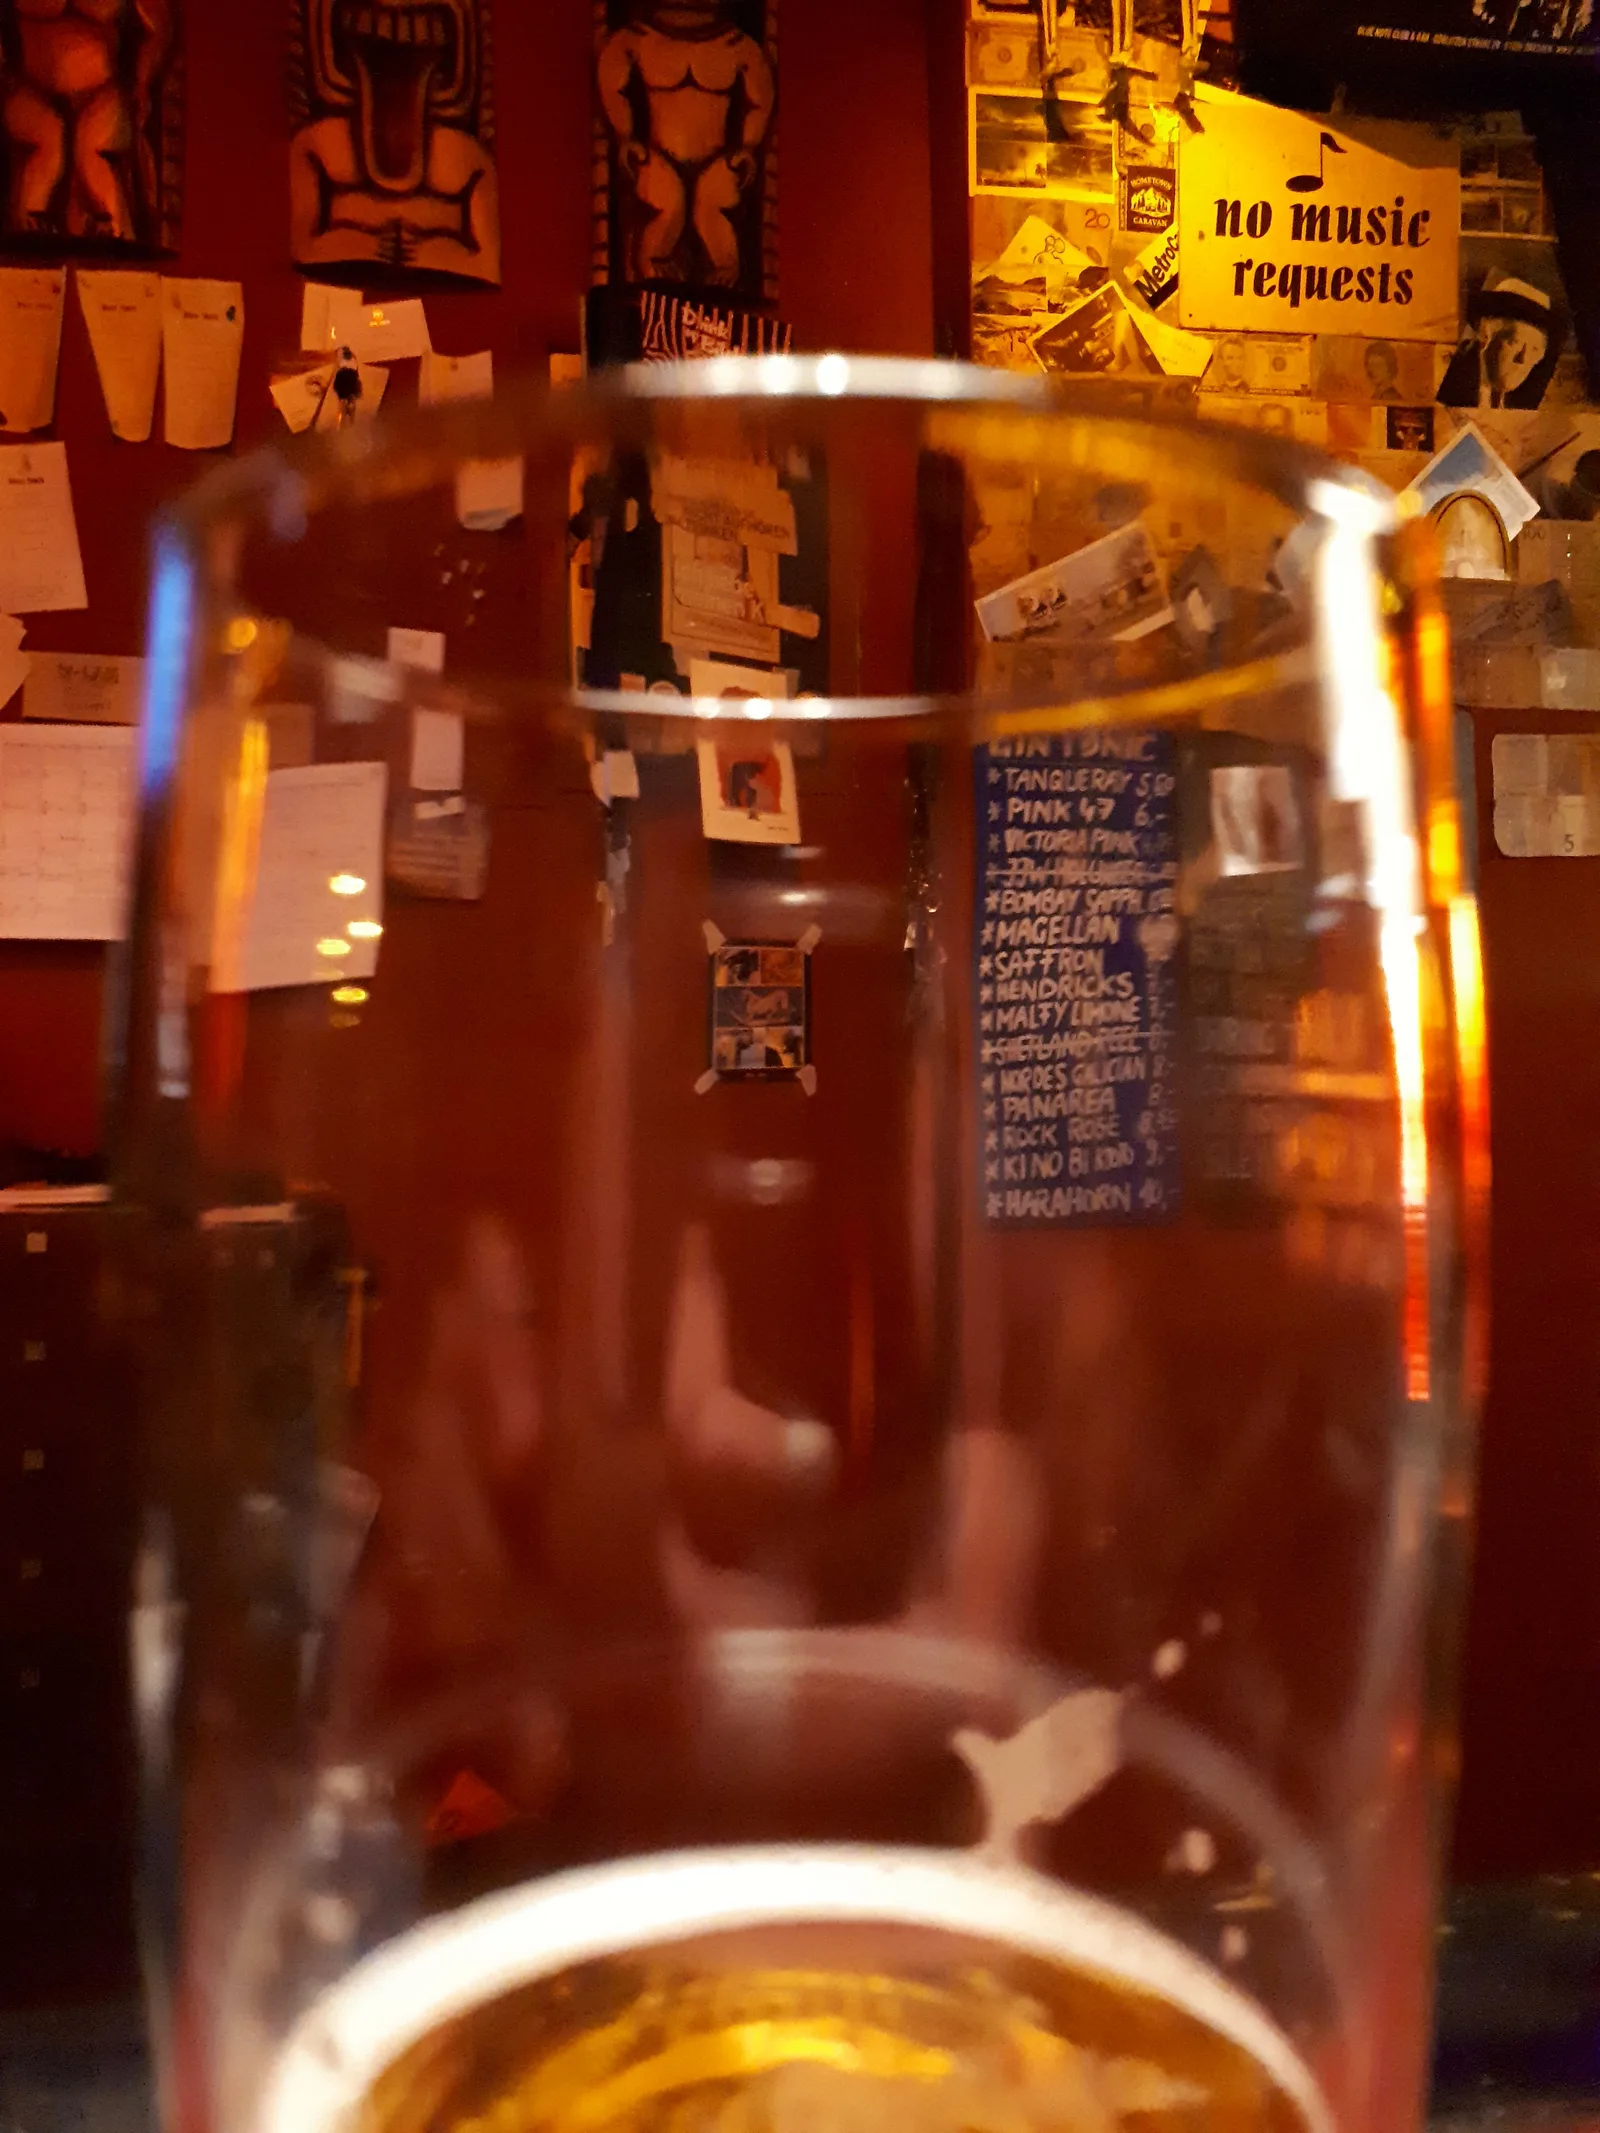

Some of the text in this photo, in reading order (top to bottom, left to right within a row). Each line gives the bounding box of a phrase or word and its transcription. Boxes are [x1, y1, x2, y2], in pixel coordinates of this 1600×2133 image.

[1130, 175, 1173, 191] HOMETOWN
[1085, 208, 1111, 228] 20
[1132, 216, 1168, 228] CARAVAN
[1213, 195, 1431, 248] no music
[1232, 258, 1414, 308] requests
[1007, 798, 1073, 824] PINK
[1079, 797, 1116, 822] 47
[1000, 887, 1081, 915] BOMBAY
[996, 914, 1120, 949] MAGELLAN
[995, 948, 1105, 982] SAFFRON
[996, 972, 1134, 1002] HENDRICKS
[1003, 1086, 1117, 1122] PANAREA
[1003, 1123, 1059, 1151] ROCK
